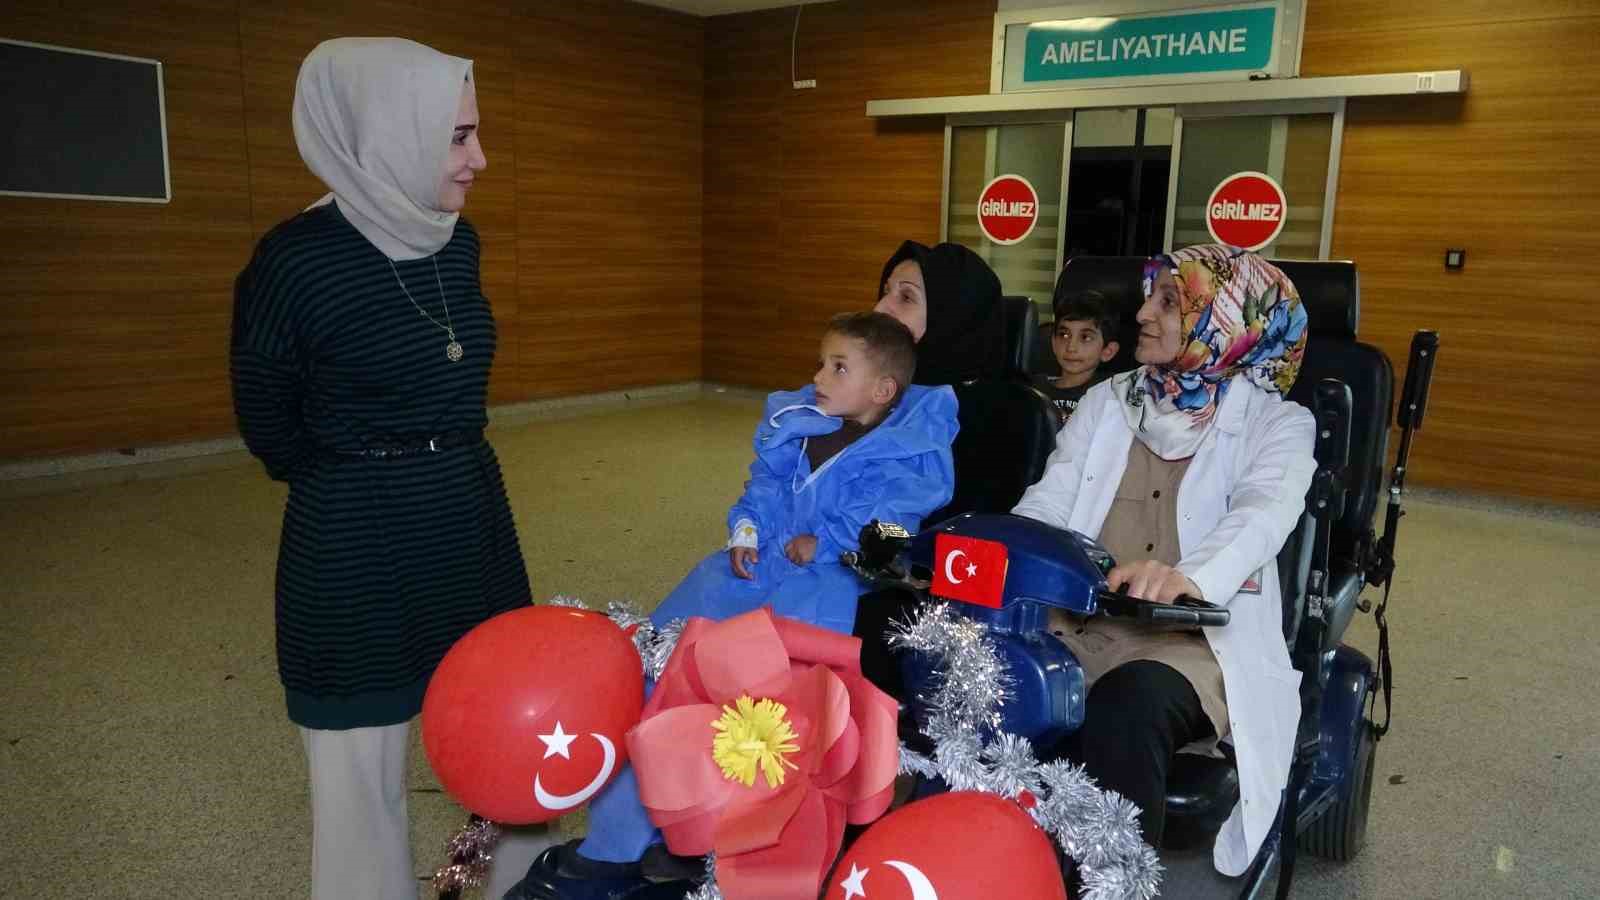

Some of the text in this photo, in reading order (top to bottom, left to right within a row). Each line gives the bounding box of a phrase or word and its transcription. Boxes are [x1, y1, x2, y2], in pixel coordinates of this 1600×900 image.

[1041, 28, 1247, 64] AMELIYATHANE
[981, 198, 1034, 217] GİRİLMEZ
[1211, 200, 1280, 221] GİRİLMEZ
